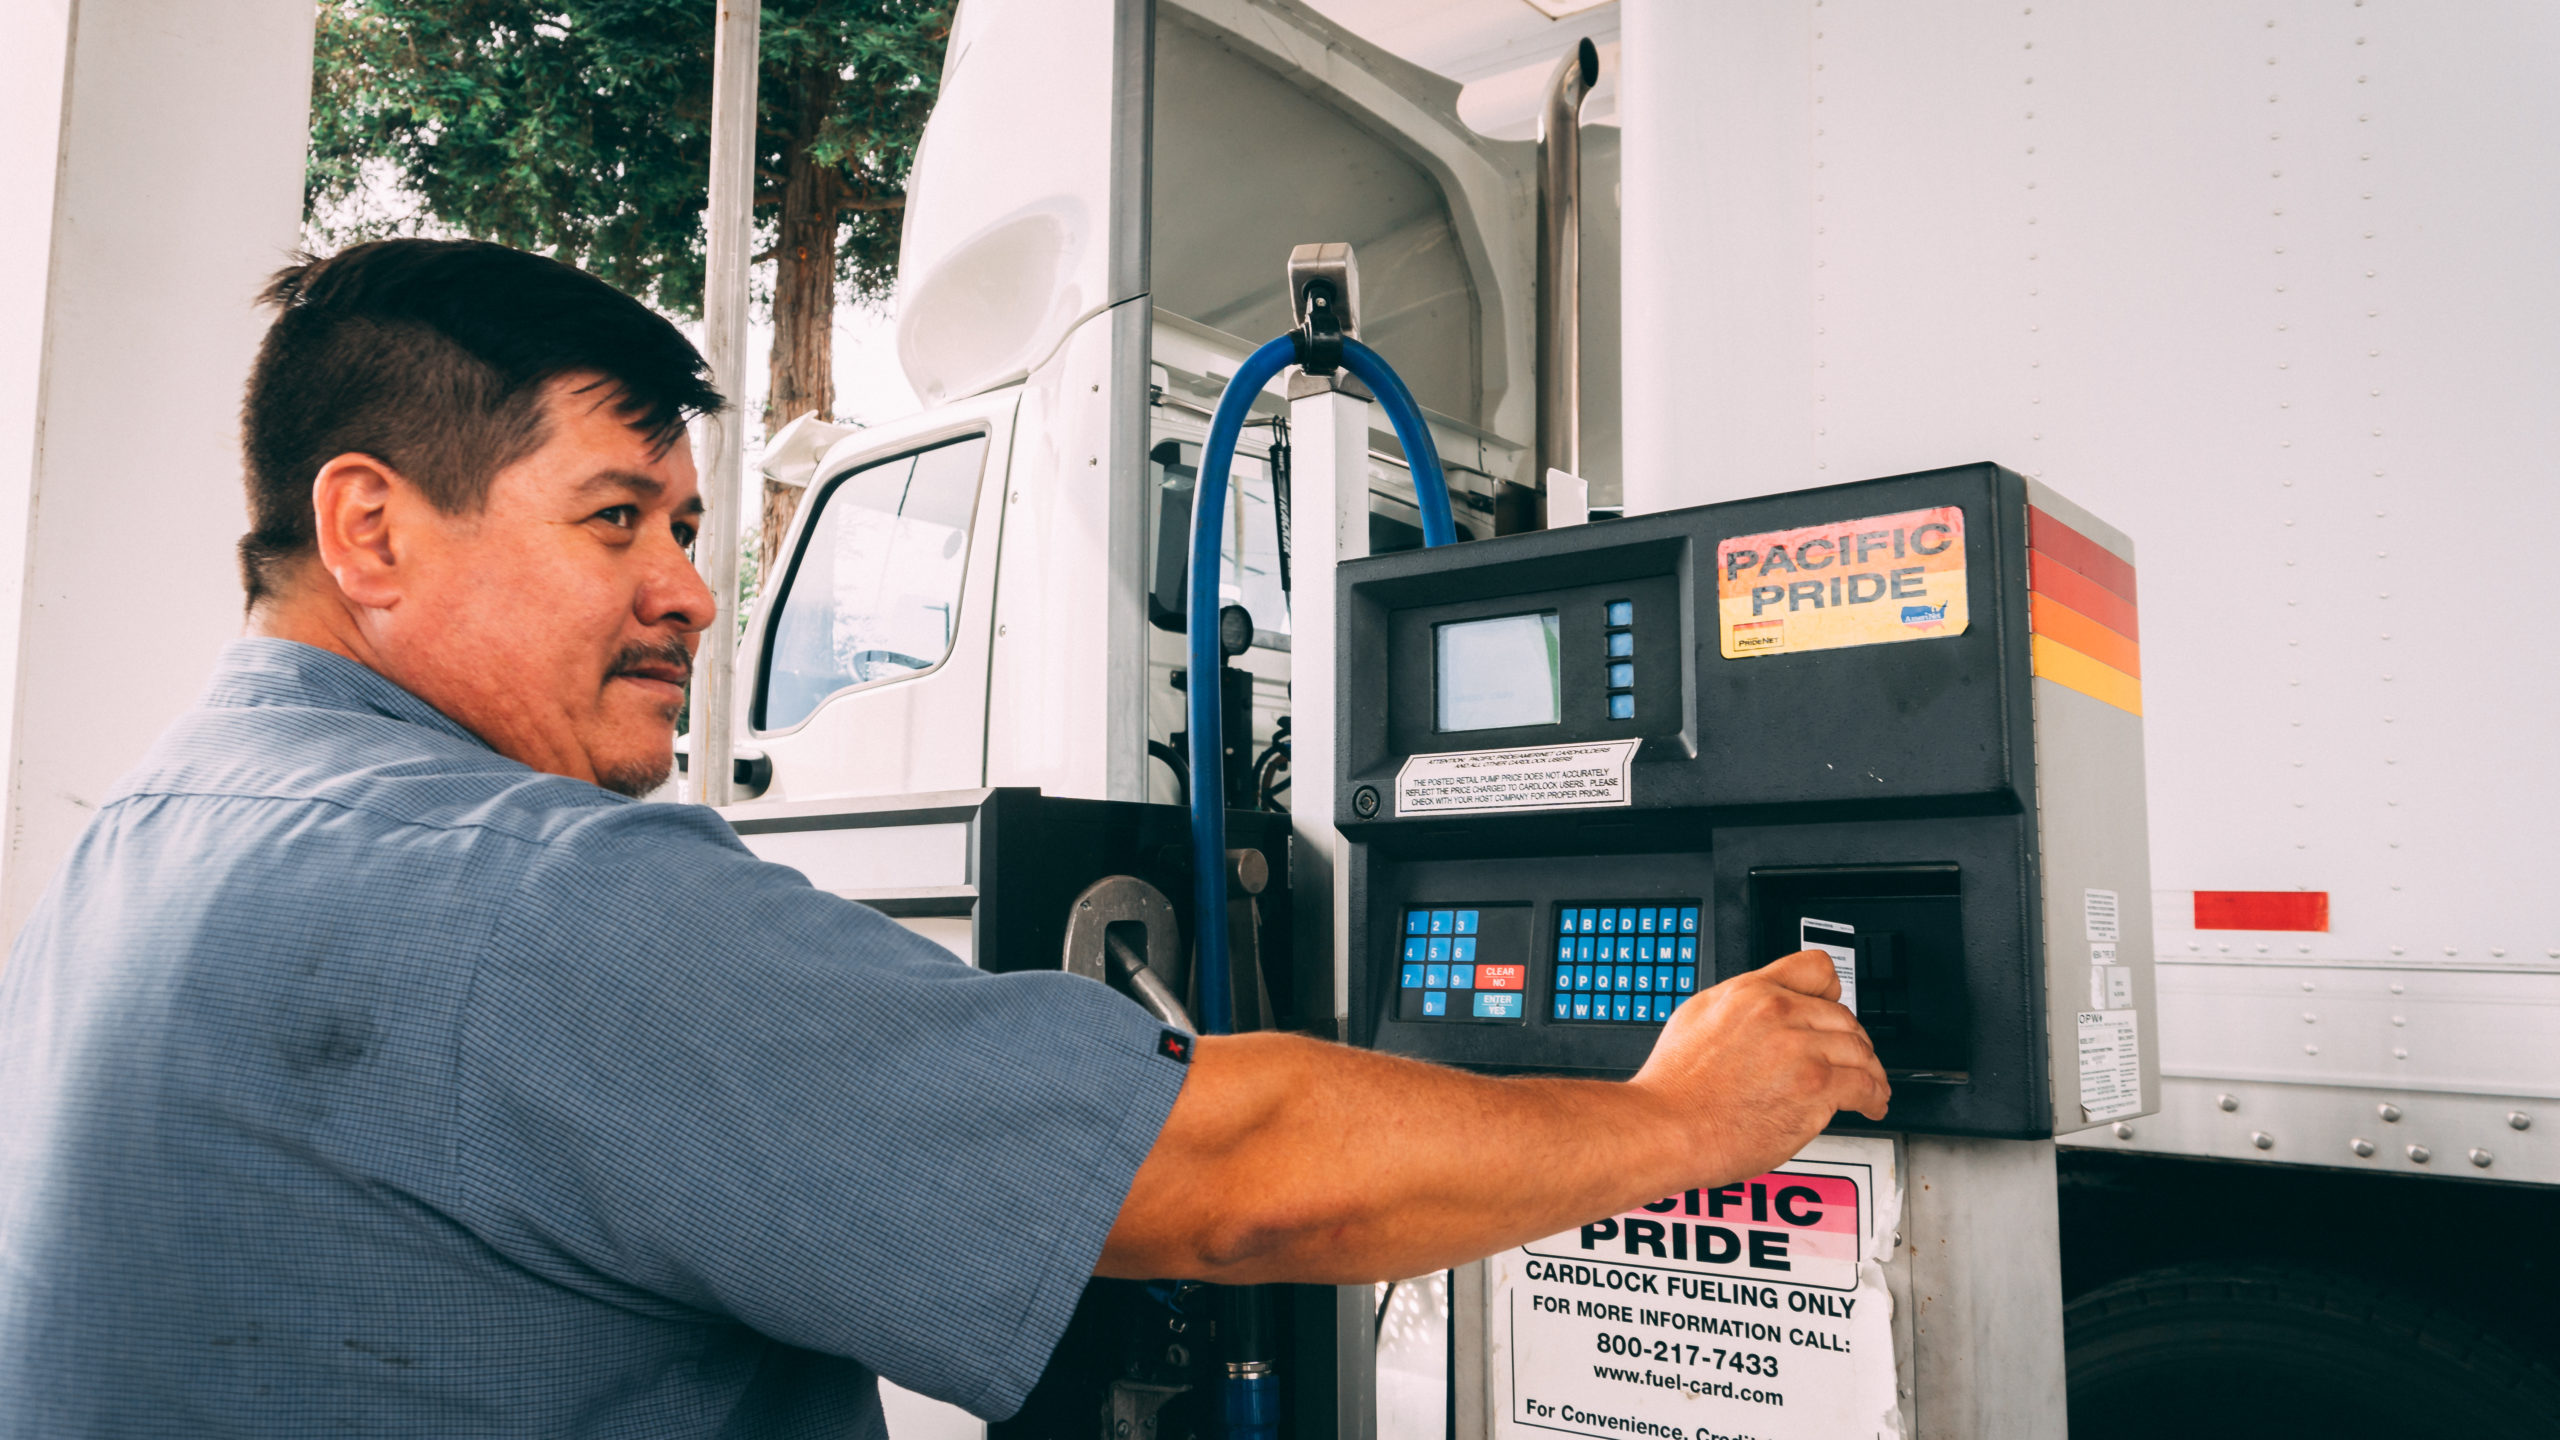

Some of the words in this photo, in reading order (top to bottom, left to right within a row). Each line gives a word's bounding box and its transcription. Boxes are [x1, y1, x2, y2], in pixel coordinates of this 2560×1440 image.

[1727, 522, 1952, 581] PACIFIC
[1752, 566, 1927, 616] PRIDE
[1414, 779, 1427, 787] THE
[1428, 778, 1455, 786] POSTED
[1456, 776, 1479, 785] RETAIL
[1480, 774, 1500, 783] PUMP
[1501, 774, 1523, 782] PRICE
[1524, 772, 1543, 781] DOES
[1545, 771, 1560, 779] NOT
[1562, 768, 1610, 778] ACCURATELY
[1405, 788, 1435, 797] REFLECT
[1436, 787, 1449, 795] THE
[1450, 786, 1471, 795] PRICE
[1472, 784, 1506, 794] CHARGED
[1508, 784, 1517, 792] TO
[1518, 781, 1558, 791] CARDLOCK
[1590, 778, 1618, 787] PLEASE
[1411, 798, 1435, 806] CHECK
[1436, 796, 1452, 805] WITH
[1453, 795, 1474, 804] YOUR
[1474, 794, 1494, 803] HOST
[1495, 792, 1528, 802] COMPANY
[1531, 791, 1546, 800] FOR
[1547, 790, 1577, 799] PROPER
[1410, 922, 1414, 931] 1
[1433, 921, 1440, 931] 2
[1458, 921, 1465, 931] 3
[1564, 920, 1572, 930] A
[1583, 919, 1592, 930] B
[1602, 919, 1612, 930] C
[1622, 919, 1631, 930] D
[1643, 919, 1651, 930] E
[1663, 919, 1672, 929] F
[1683, 918, 1693, 930] G
[1407, 948, 1413, 957] 4
[1430, 948, 1437, 958] 5
[1455, 948, 1462, 958] 6
[1562, 948, 1571, 958] H
[1601, 948, 1609, 958] J
[1620, 948, 1630, 959] K
[1641, 948, 1649, 959] L
[1660, 948, 1671, 959] M
[1682, 948, 1692, 959] N
[1485, 967, 1515, 976] CLEAR
[1404, 975, 1411, 984] 7
[1428, 975, 1434, 985] 8
[1453, 975, 1460, 985] 9
[1492, 978, 1505, 987] NO
[1559, 976, 1569, 987] O
[1579, 976, 1588, 987] P
[1598, 976, 1608, 988] Q
[1619, 977, 1628, 987] R
[1639, 977, 1648, 988] S
[1660, 977, 1669, 988] T
[1680, 977, 1690, 988] U
[1484, 995, 1512, 1004] ENTER
[1426, 1002, 1432, 1012] 0
[1489, 1006, 1506, 1015] YES
[1558, 1004, 1567, 1015] V
[1576, 1005, 1588, 1016] W
[1597, 1005, 1606, 1016] X
[1618, 1006, 1626, 1016] Y
[1637, 1006, 1646, 1017] Z
[1642, 1181, 1824, 1227] IFIC
[1580, 1217, 1791, 1272] PRIDE
[1525, 1260, 1660, 1295] CARDLOCK
[1667, 1276, 1778, 1309] FUELING
[1788, 1290, 1856, 1320] ONLY
[1533, 1295, 1571, 1315] FOR
[1577, 1301, 1633, 1323] MORE
[1640, 1308, 1782, 1343] INFORMATION
[1789, 1328, 1851, 1354] CALL:
[1596, 1332, 1779, 1378] 800-217-7433
[1593, 1364, 1784, 1407] www.fuel-card.com
[1526, 1399, 1555, 1419] For
